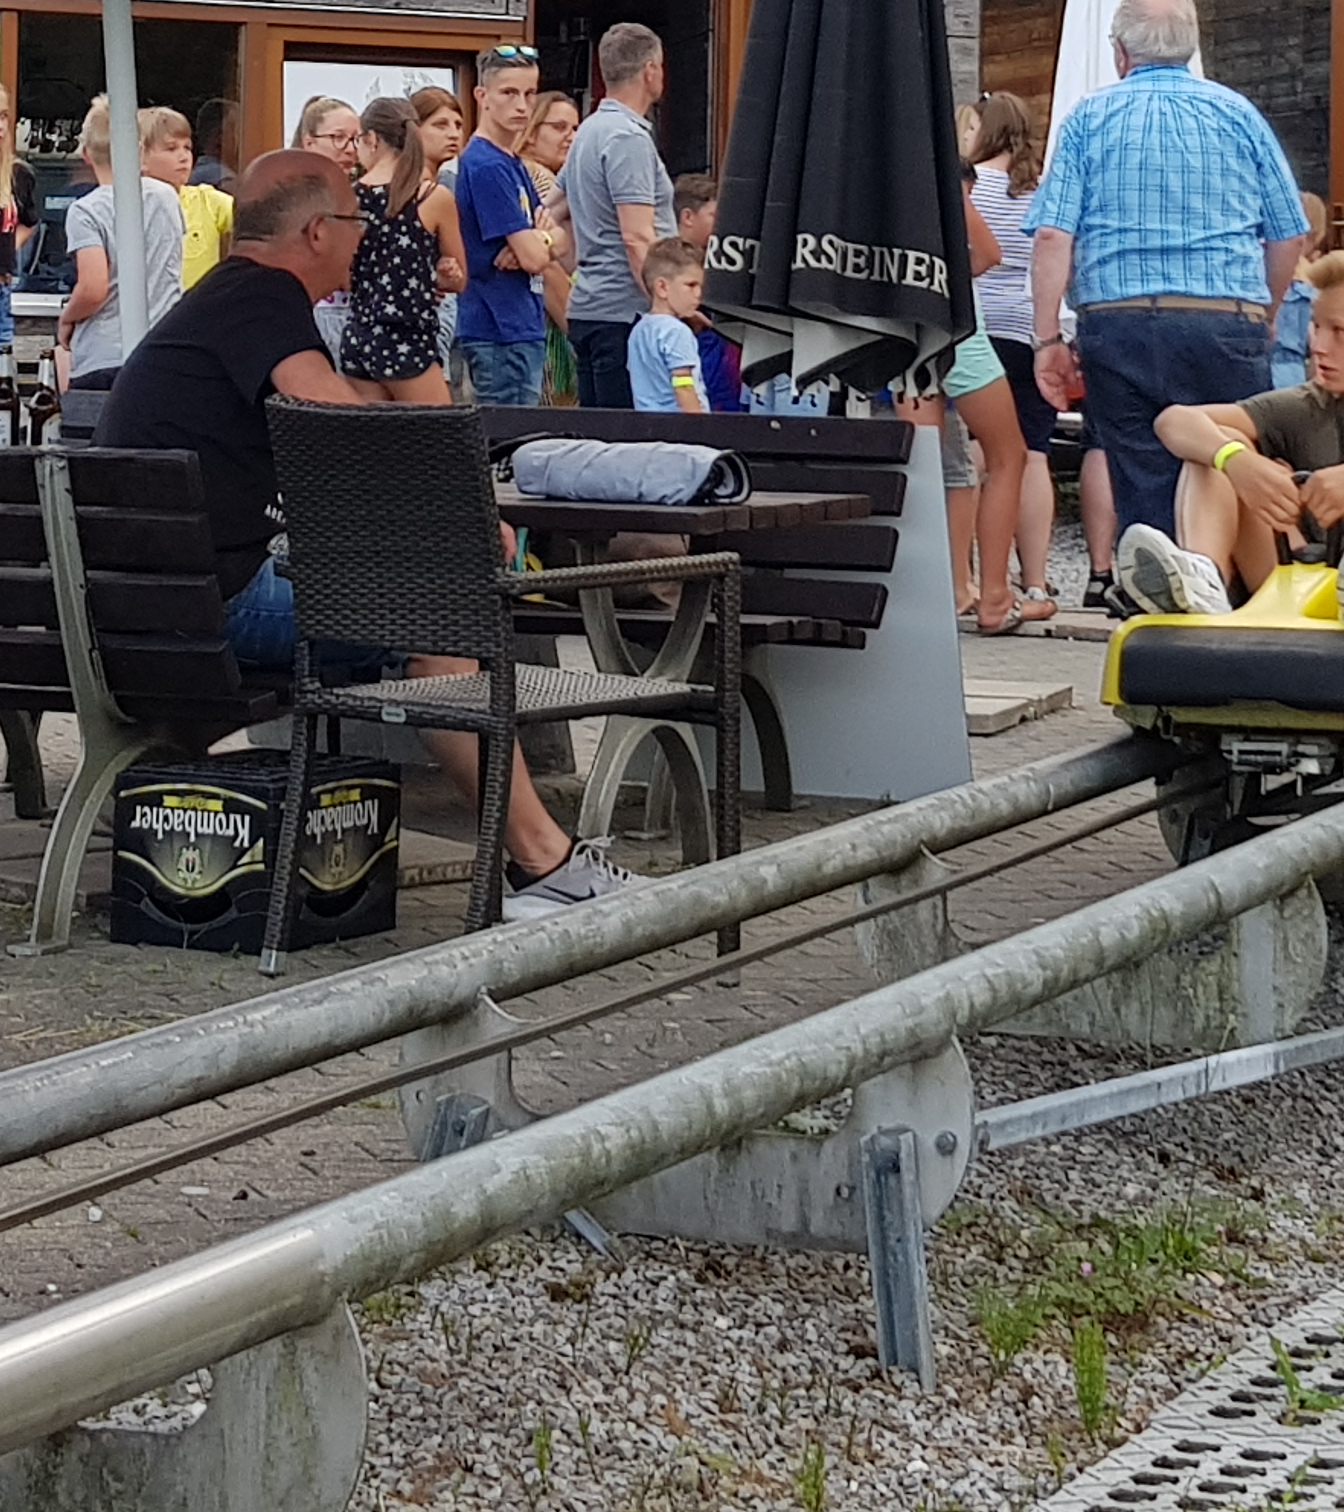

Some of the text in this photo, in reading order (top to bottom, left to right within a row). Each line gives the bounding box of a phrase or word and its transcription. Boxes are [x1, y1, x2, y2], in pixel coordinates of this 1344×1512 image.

[791, 233, 950, 299] RSTEINER
[130, 804, 251, 848] Krombacher
[306, 798, 379, 845] Krombache
